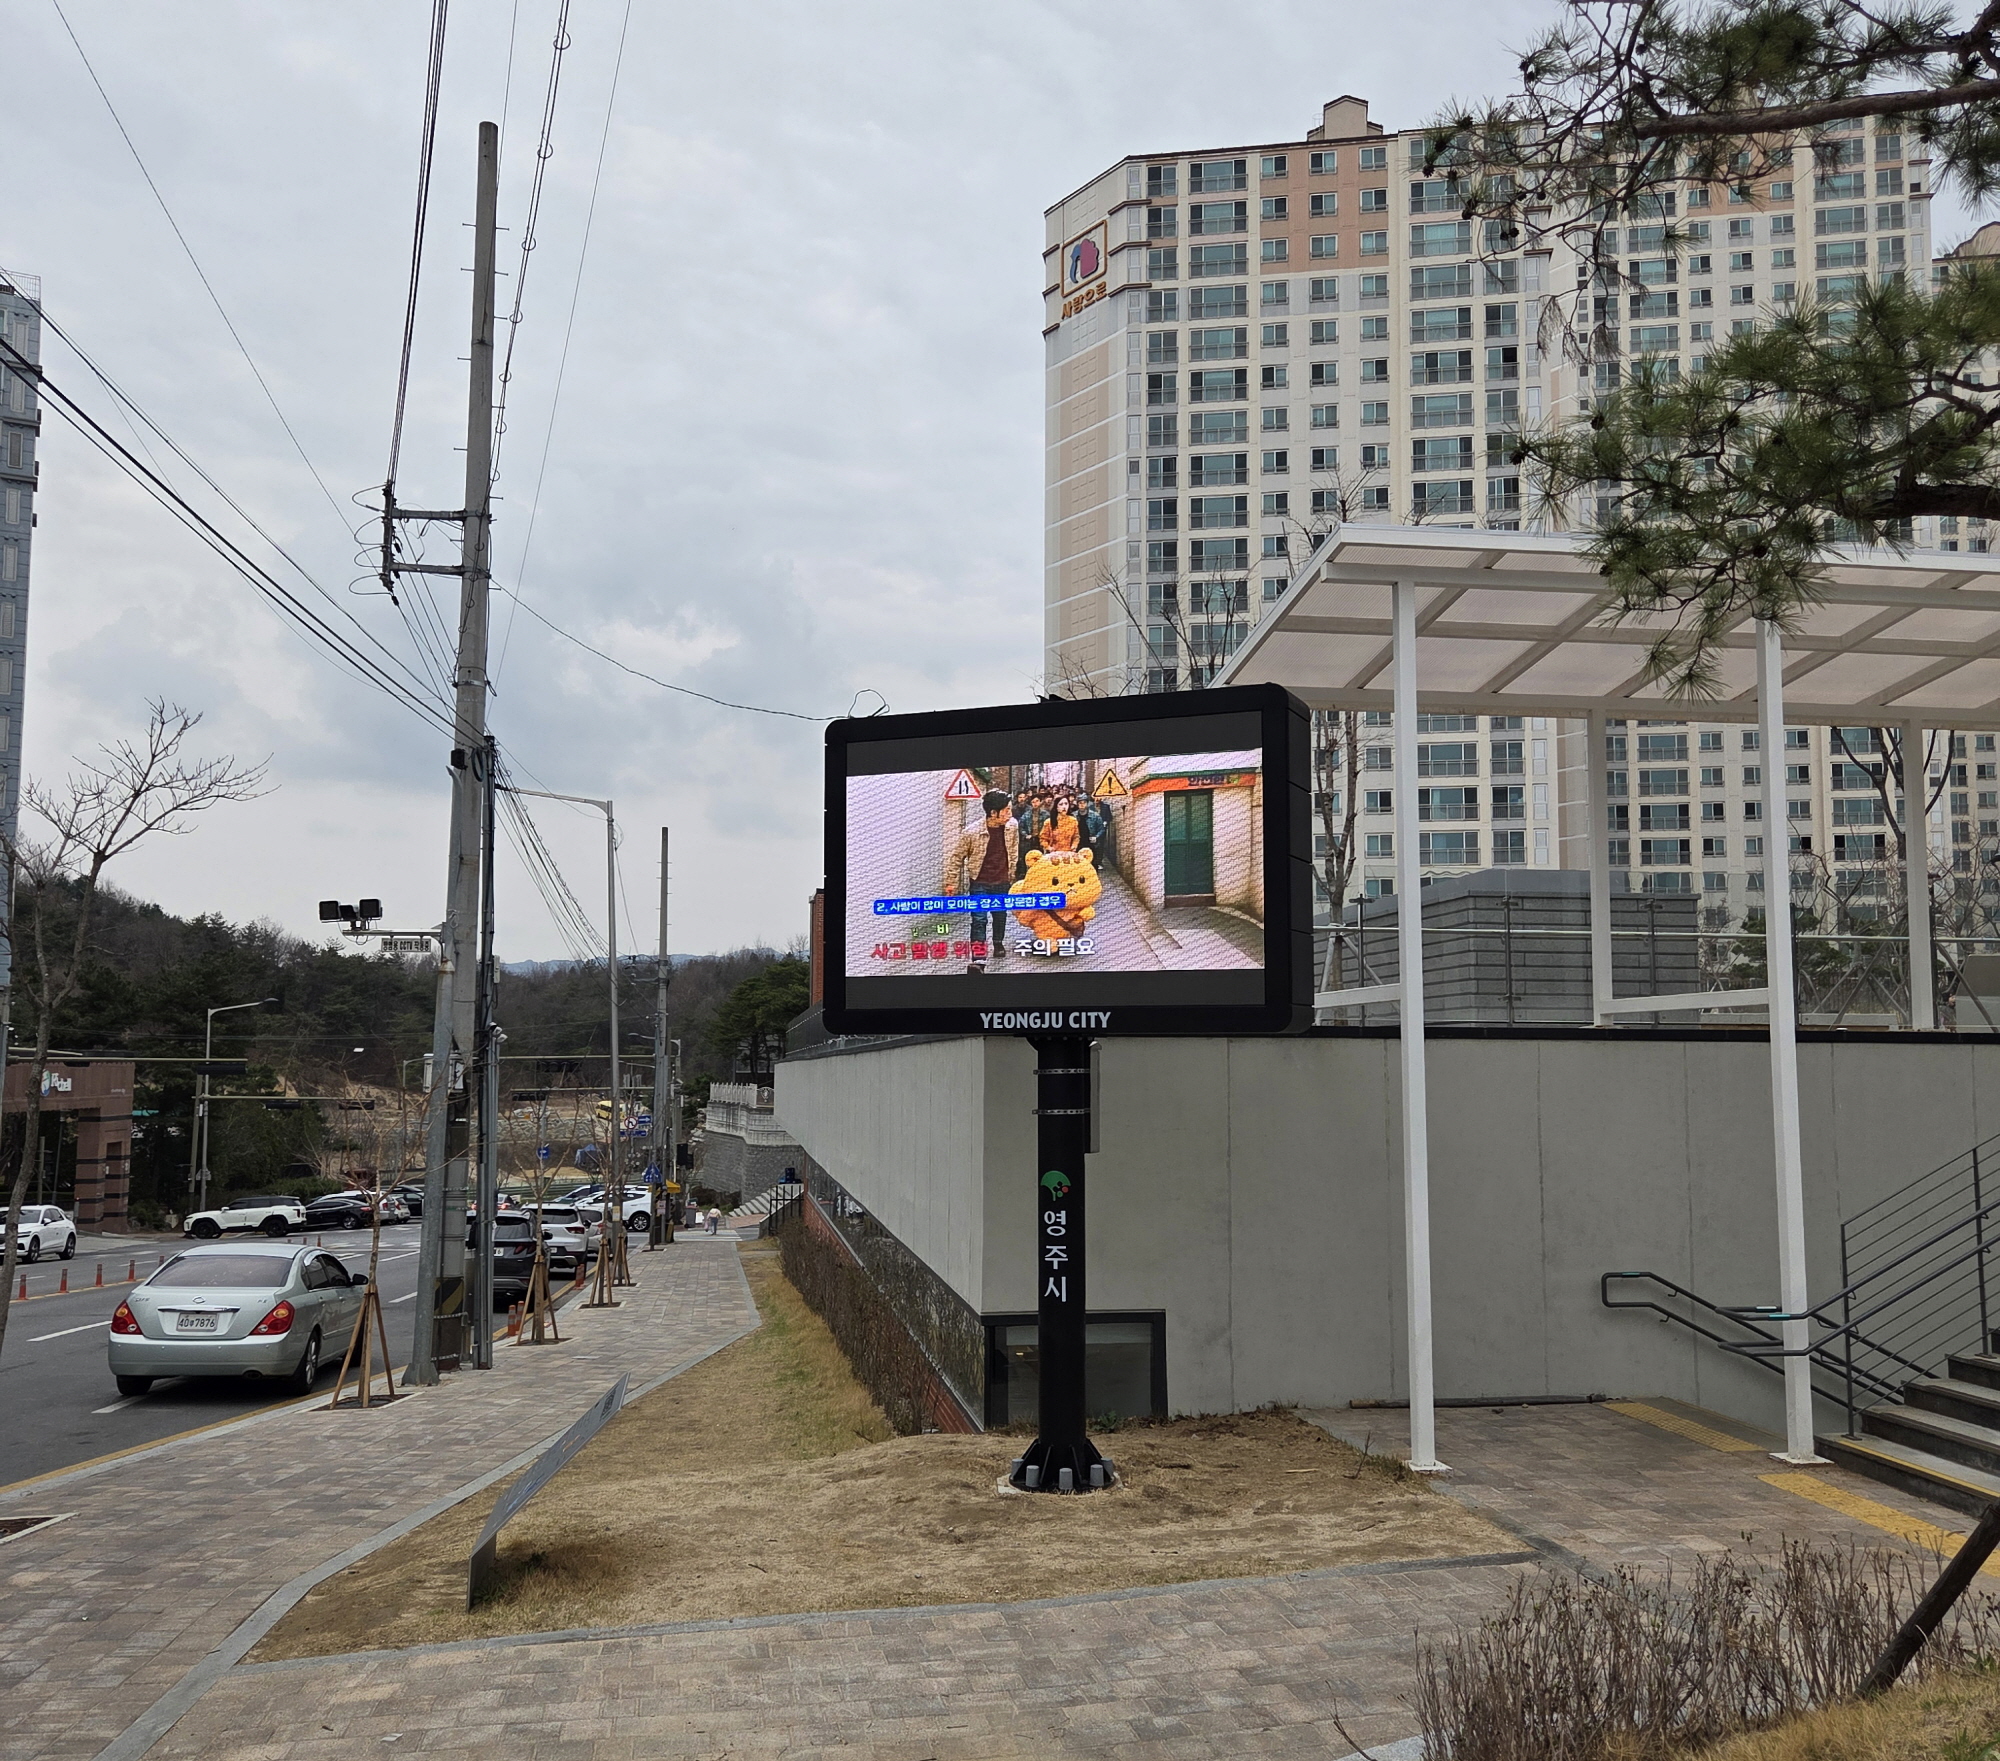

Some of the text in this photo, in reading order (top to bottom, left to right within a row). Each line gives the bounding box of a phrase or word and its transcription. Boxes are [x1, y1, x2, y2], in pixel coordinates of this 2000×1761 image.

[1061, 281, 1108, 320] 사랑으로
[890, 901, 920, 912] 사람이
[923, 900, 944, 911] 많이
[947, 899, 978, 910] 모이는
[979, 898, 1002, 909] 장소
[1004, 897, 1036, 909] 방문한
[1039, 896, 1061, 907] 경우
[399, 940, 413, 951] CCTV
[870, 937, 1096, 960] 사고 발생 위험 주의 필요
[980, 1011, 1111, 1029] YEONGJU CITY
[1043, 1210, 1069, 1302] 영주시
